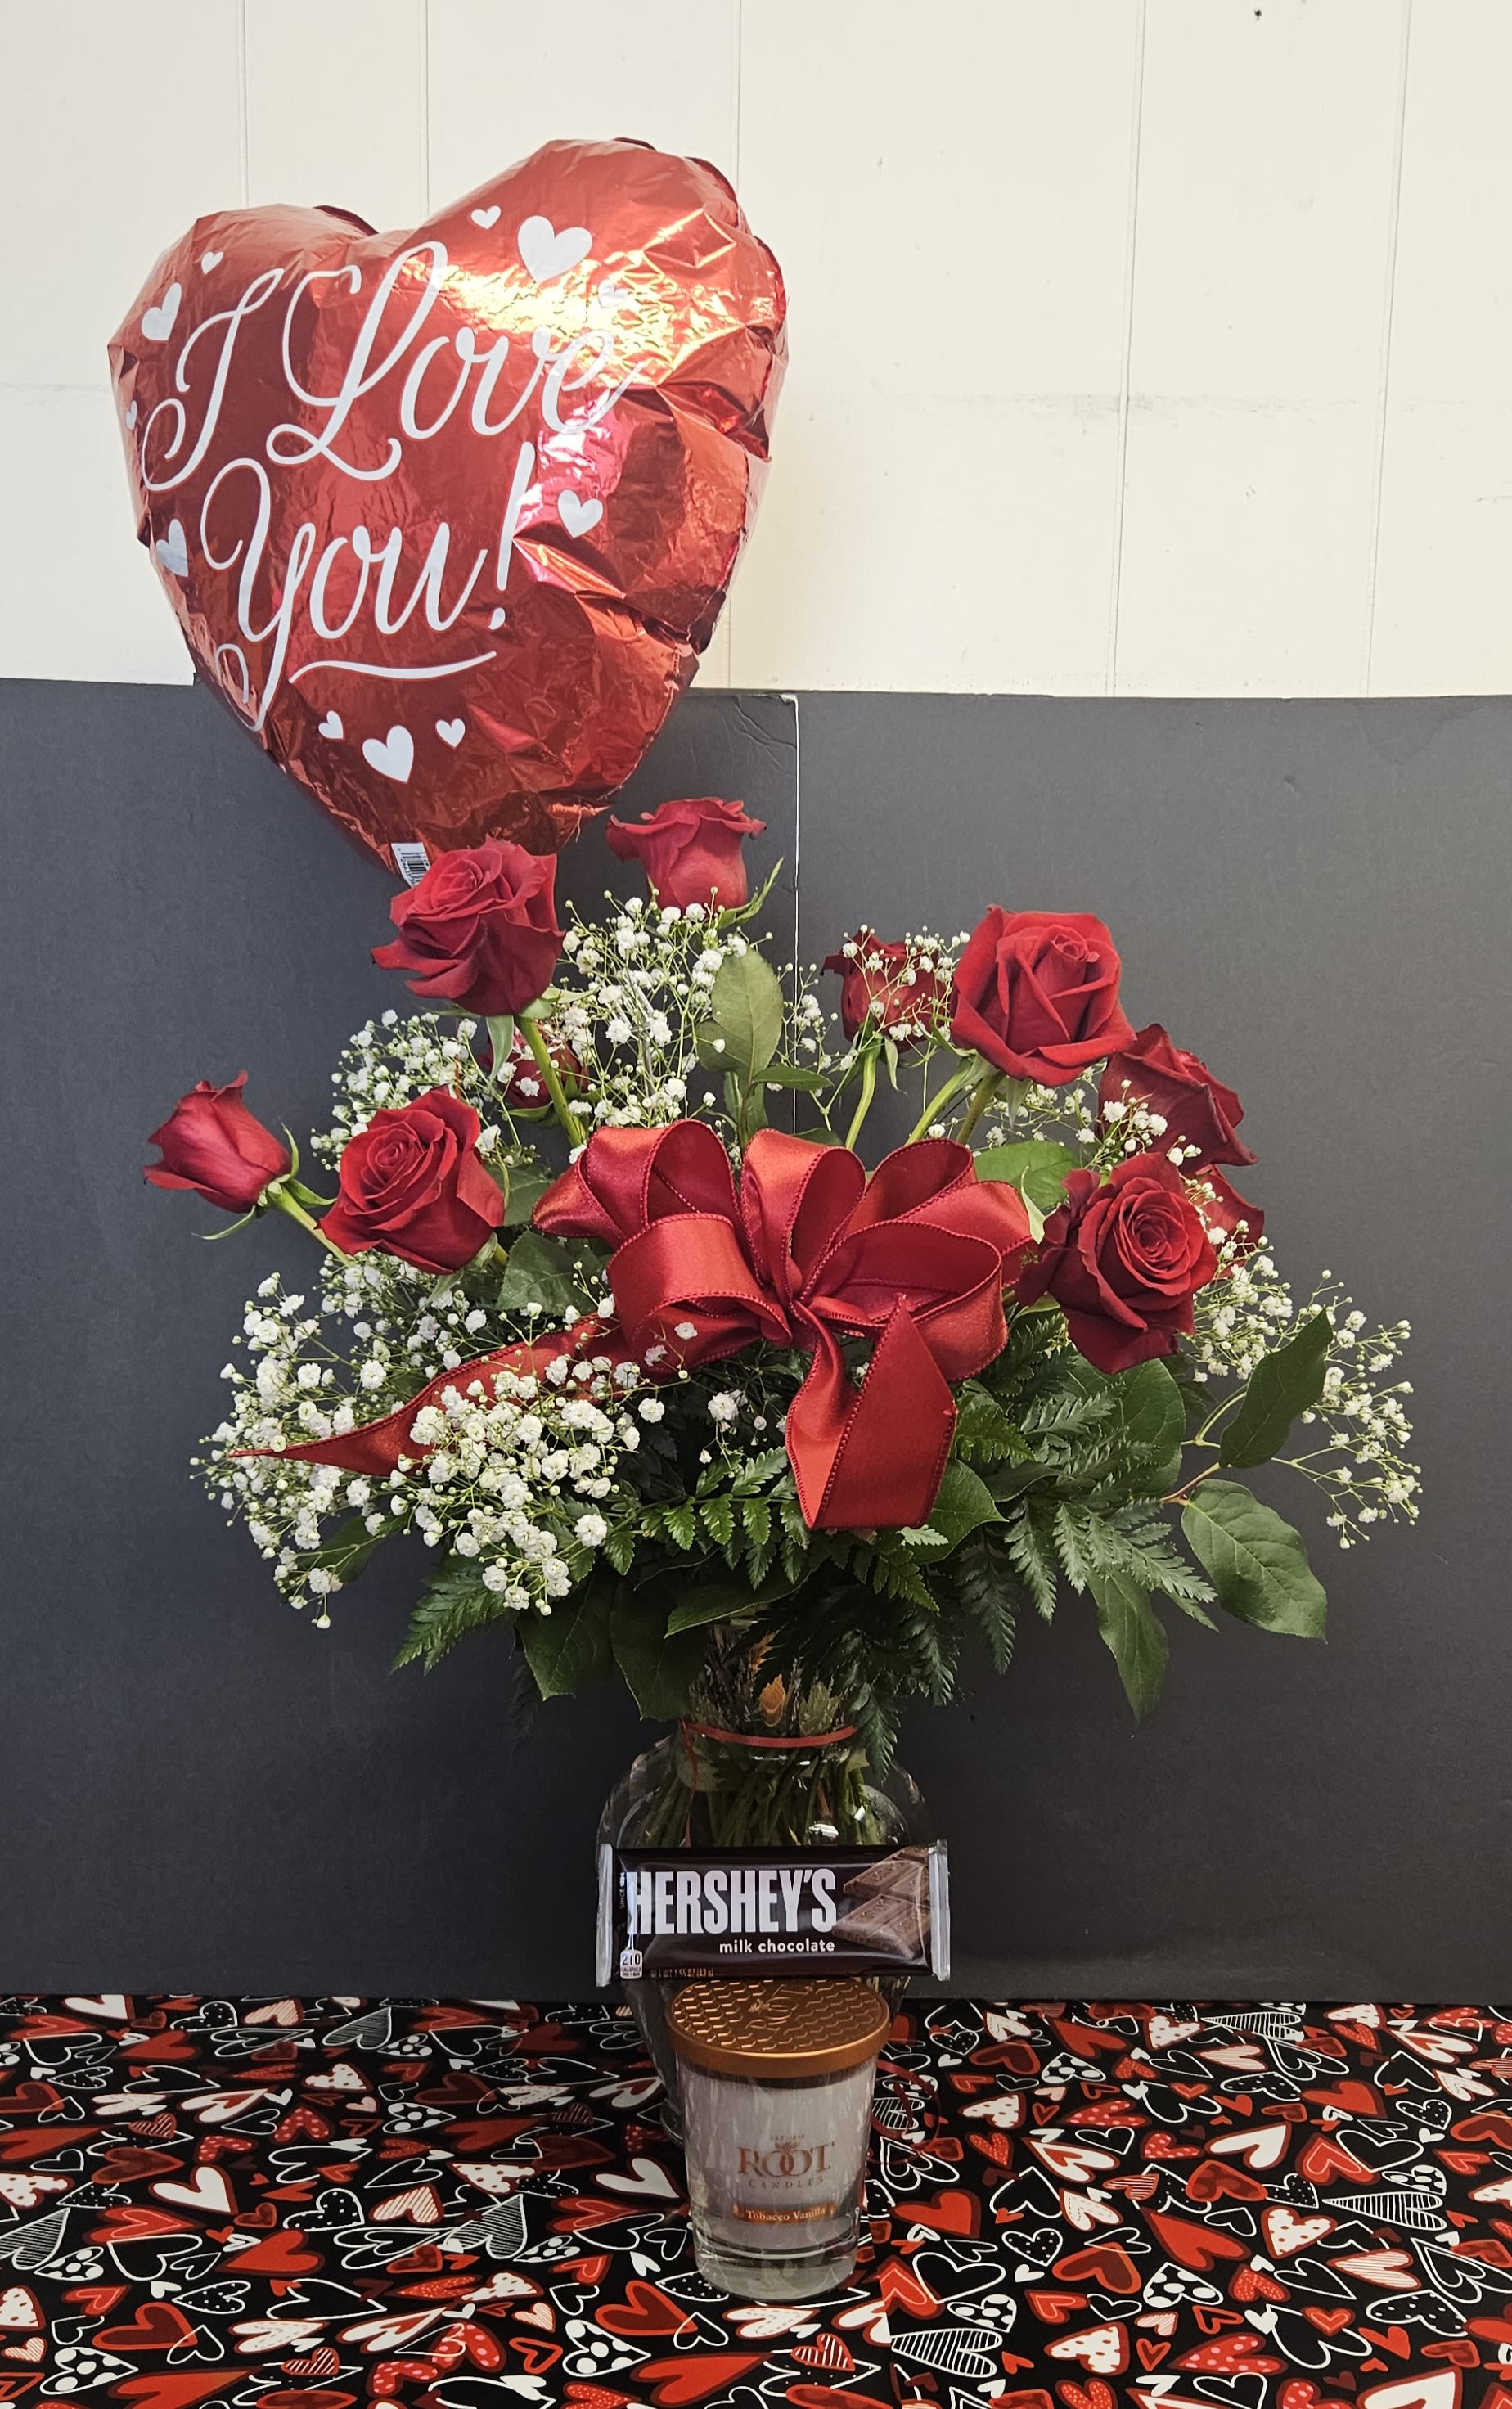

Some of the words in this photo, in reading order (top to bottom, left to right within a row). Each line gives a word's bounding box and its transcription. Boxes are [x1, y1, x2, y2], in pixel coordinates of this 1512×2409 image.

[142, 268, 285, 490] I
[266, 241, 646, 480] Love
[200, 440, 536, 731] You!
[627, 1868, 837, 1934] HERSHEY'S
[719, 1938, 752, 1953] milk
[758, 1938, 835, 1952] chocolate
[622, 1953, 641, 1965] 210
[738, 2141, 834, 2177] ROOT
[749, 2176, 824, 2189] CANDLES
[746, 2209, 790, 2221] Tobacco
[792, 2207, 826, 2220] Vanilla
